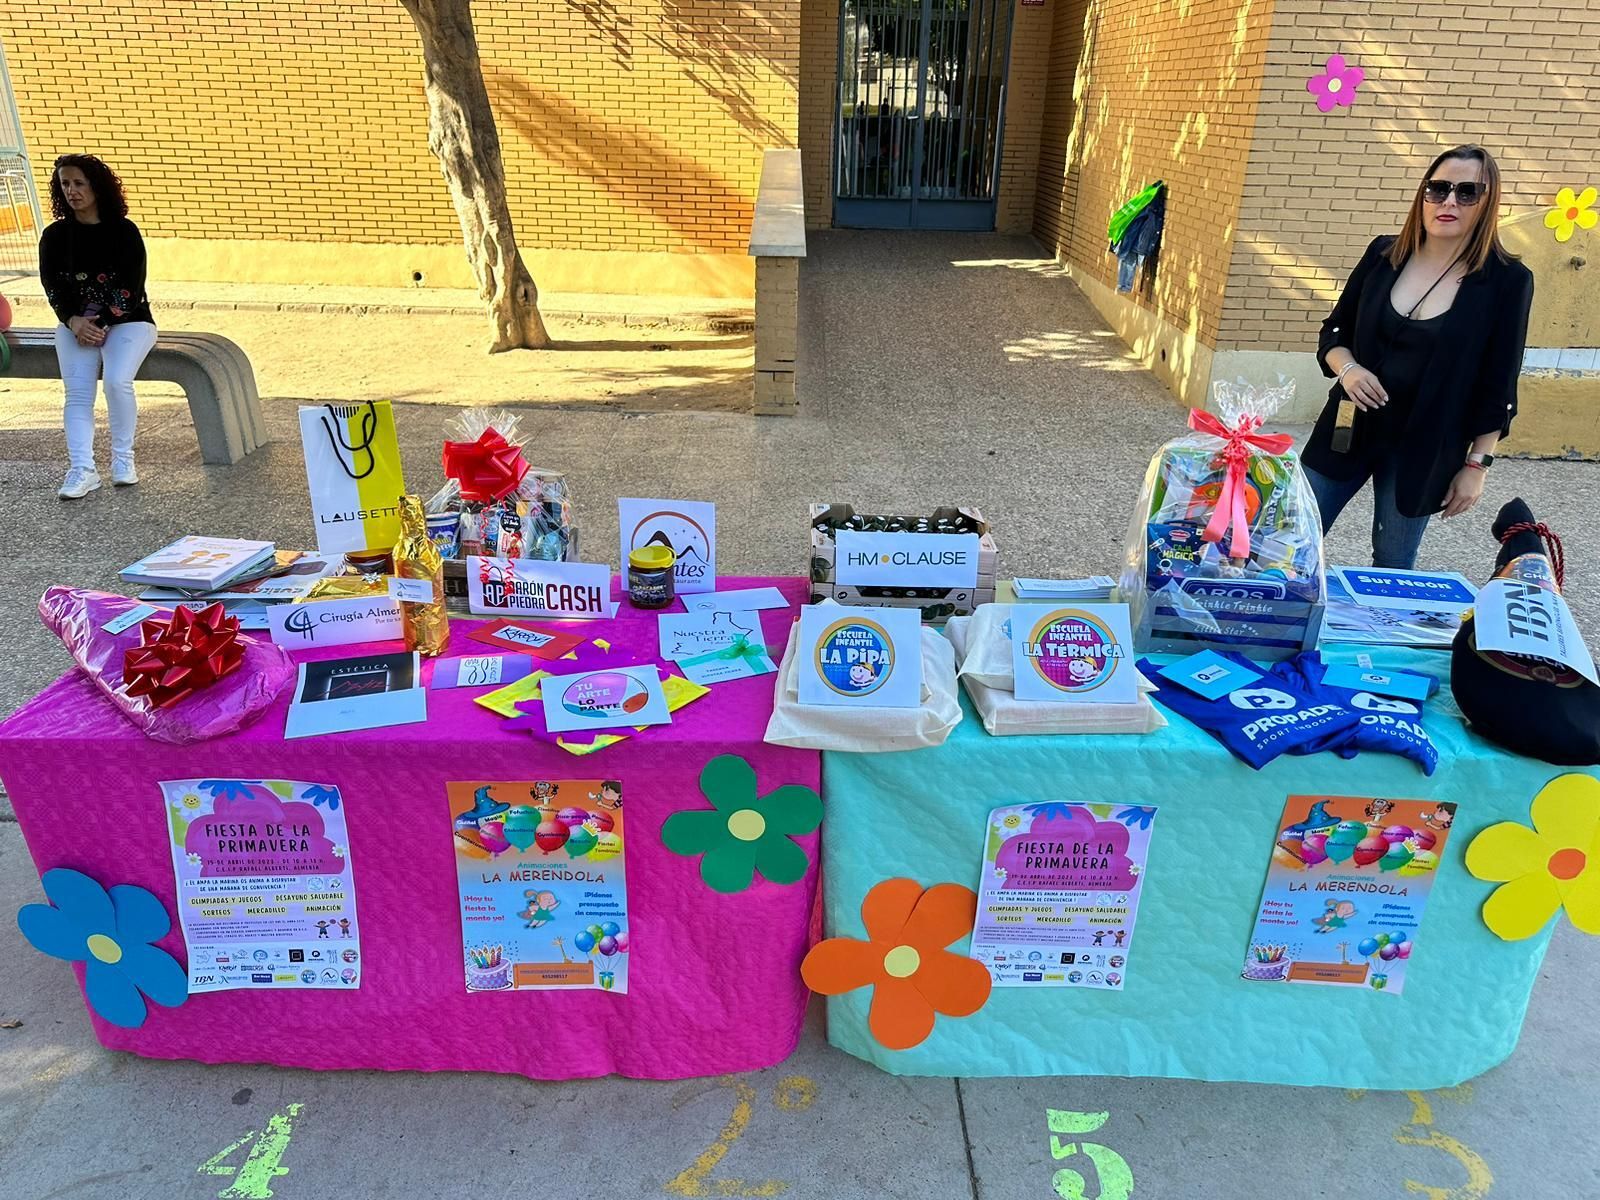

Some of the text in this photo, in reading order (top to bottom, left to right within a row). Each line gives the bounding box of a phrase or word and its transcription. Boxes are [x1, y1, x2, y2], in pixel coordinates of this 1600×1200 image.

[892, 551, 967, 566] CLAUSE
[674, 562, 706, 577] ntes
[1357, 575, 1393, 586] Sur
[510, 596, 545, 610] PIEDRA
[546, 583, 603, 613] CASH
[1234, 600, 1273, 613] Twinkle
[1503, 582, 1553, 642] TBN
[320, 608, 401, 624] Cirugía Almer
[673, 630, 725, 638] Nuestra
[837, 631, 873, 639] ESCUELA
[1050, 625, 1091, 633] ESCUELA
[836, 639, 874, 647] INFANTIL
[1049, 633, 1093, 642] INFANTIL
[1022, 642, 1044, 657] LA
[820, 648, 842, 665] LA
[331, 664, 390, 675] ESTÉTICA
[576, 683, 593, 692] TU
[578, 688, 611, 700] ARTE
[580, 702, 621, 712] PARTE
[1241, 703, 1343, 741] PROPADE
[1257, 728, 1290, 750] SPORT
[206, 824, 310, 837] FIESTA DE LA
[219, 839, 309, 853] PRIMAVERA
[1017, 842, 1114, 855] FIESTA DE LA
[1025, 857, 1108, 869] PRIMAVERA
[482, 870, 605, 884] LA MERENDOLA
[1288, 881, 1408, 896] LA MERENDOLA
[247, 907, 286, 915] MERCADILLO
[196, 1103, 305, 1199] 4
[1046, 1108, 1135, 1200] 5
